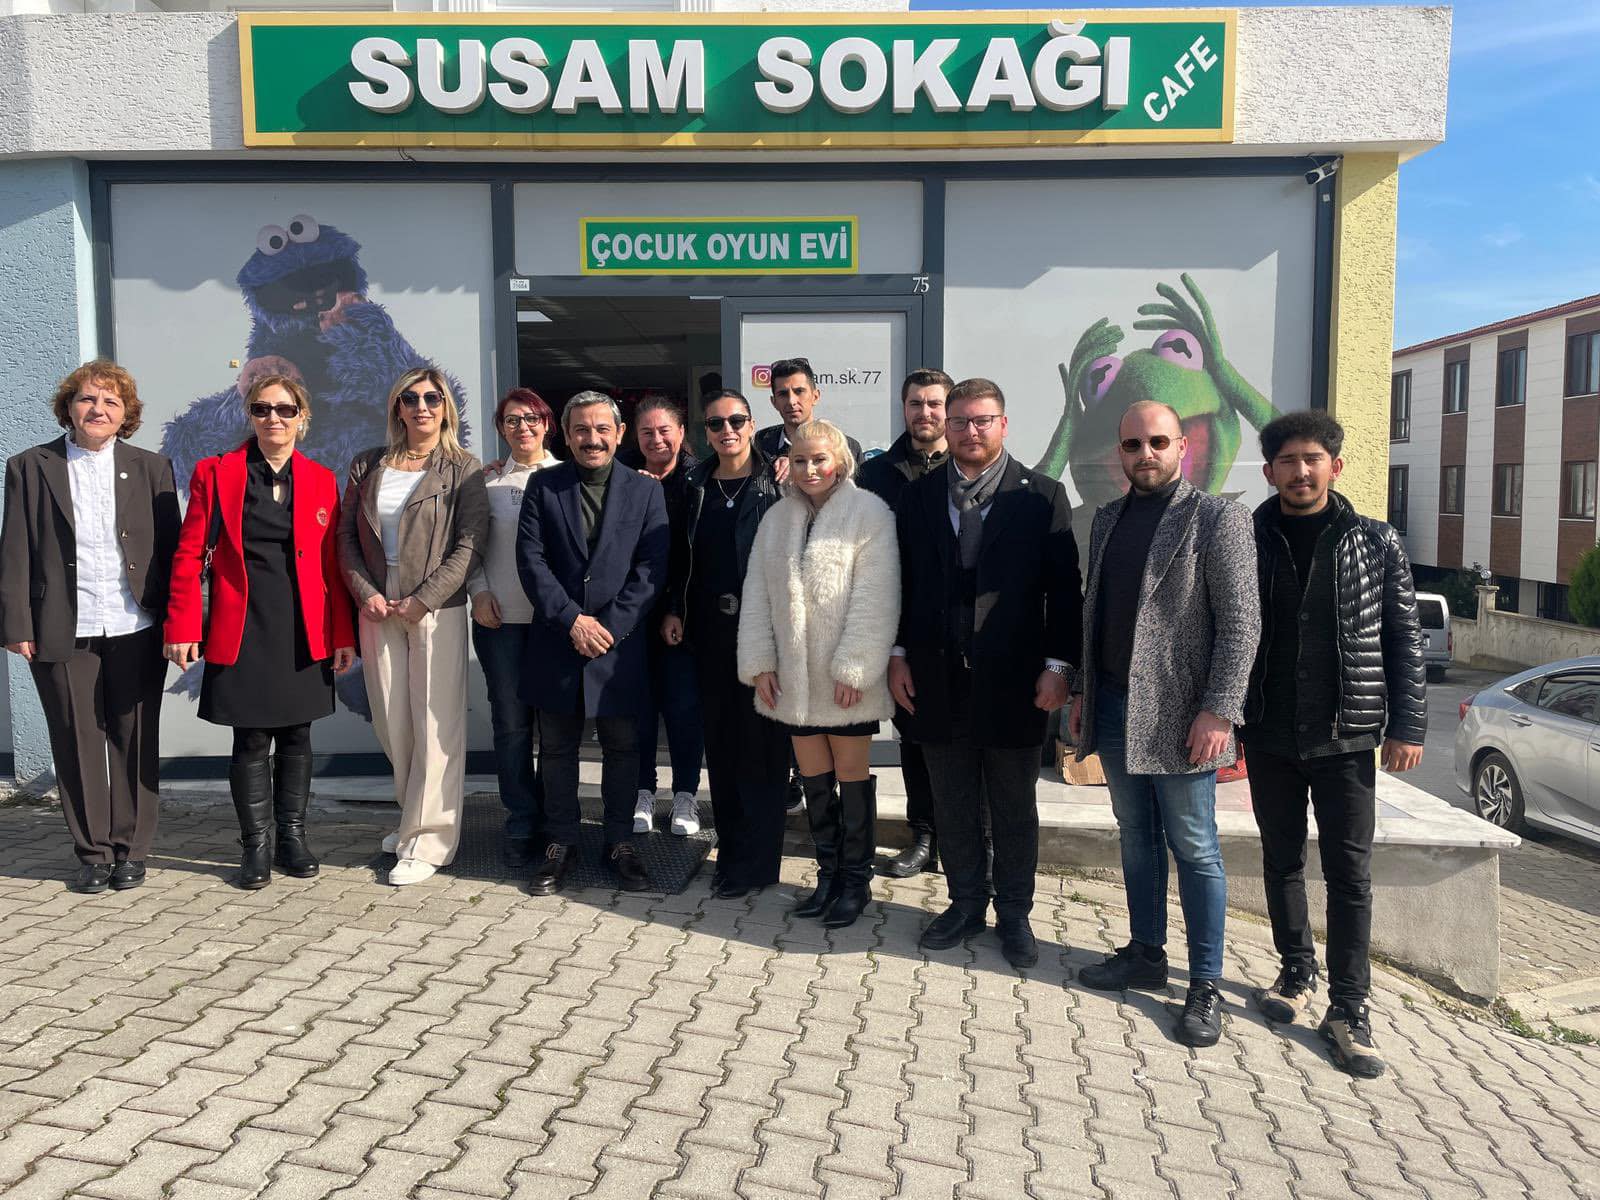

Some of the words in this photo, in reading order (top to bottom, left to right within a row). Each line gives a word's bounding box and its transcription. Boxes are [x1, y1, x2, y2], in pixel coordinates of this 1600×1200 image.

[348, 37, 705, 115] SUSAM
[754, 19, 1130, 114] SOKAĞI
[1143, 36, 1218, 122] CAFE
[591, 233, 697, 267] ÇOCUK
[707, 233, 788, 260] OYUN
[800, 227, 847, 259] EVİ
[912, 277, 930, 293] 75
[813, 371, 881, 384] am.sk.77
